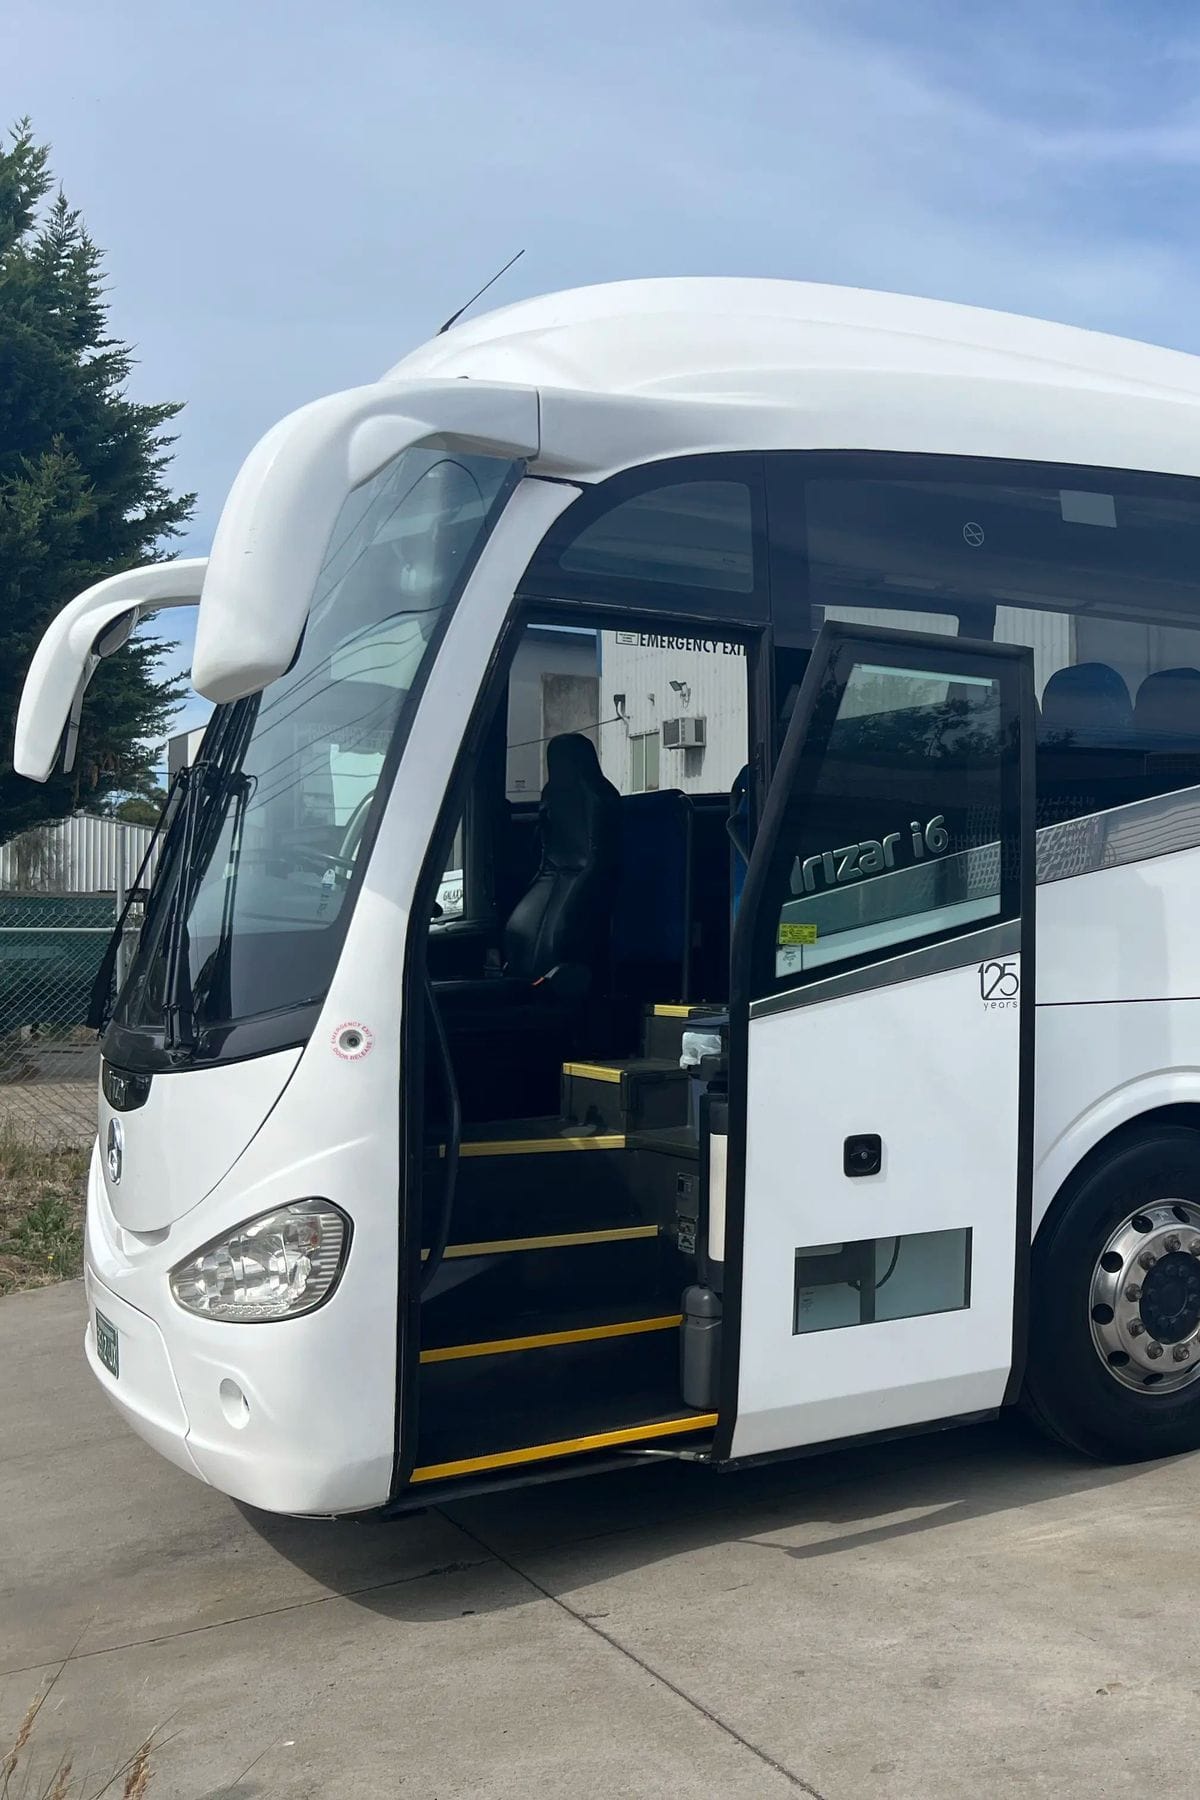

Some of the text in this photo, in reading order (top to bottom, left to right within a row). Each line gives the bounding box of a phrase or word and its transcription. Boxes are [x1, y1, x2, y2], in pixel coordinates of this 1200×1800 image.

[640, 633, 718, 653] EMERGENCY
[910, 814, 949, 858] i6
[977, 962, 1019, 1000] 125
[984, 1000, 1018, 1011] years
